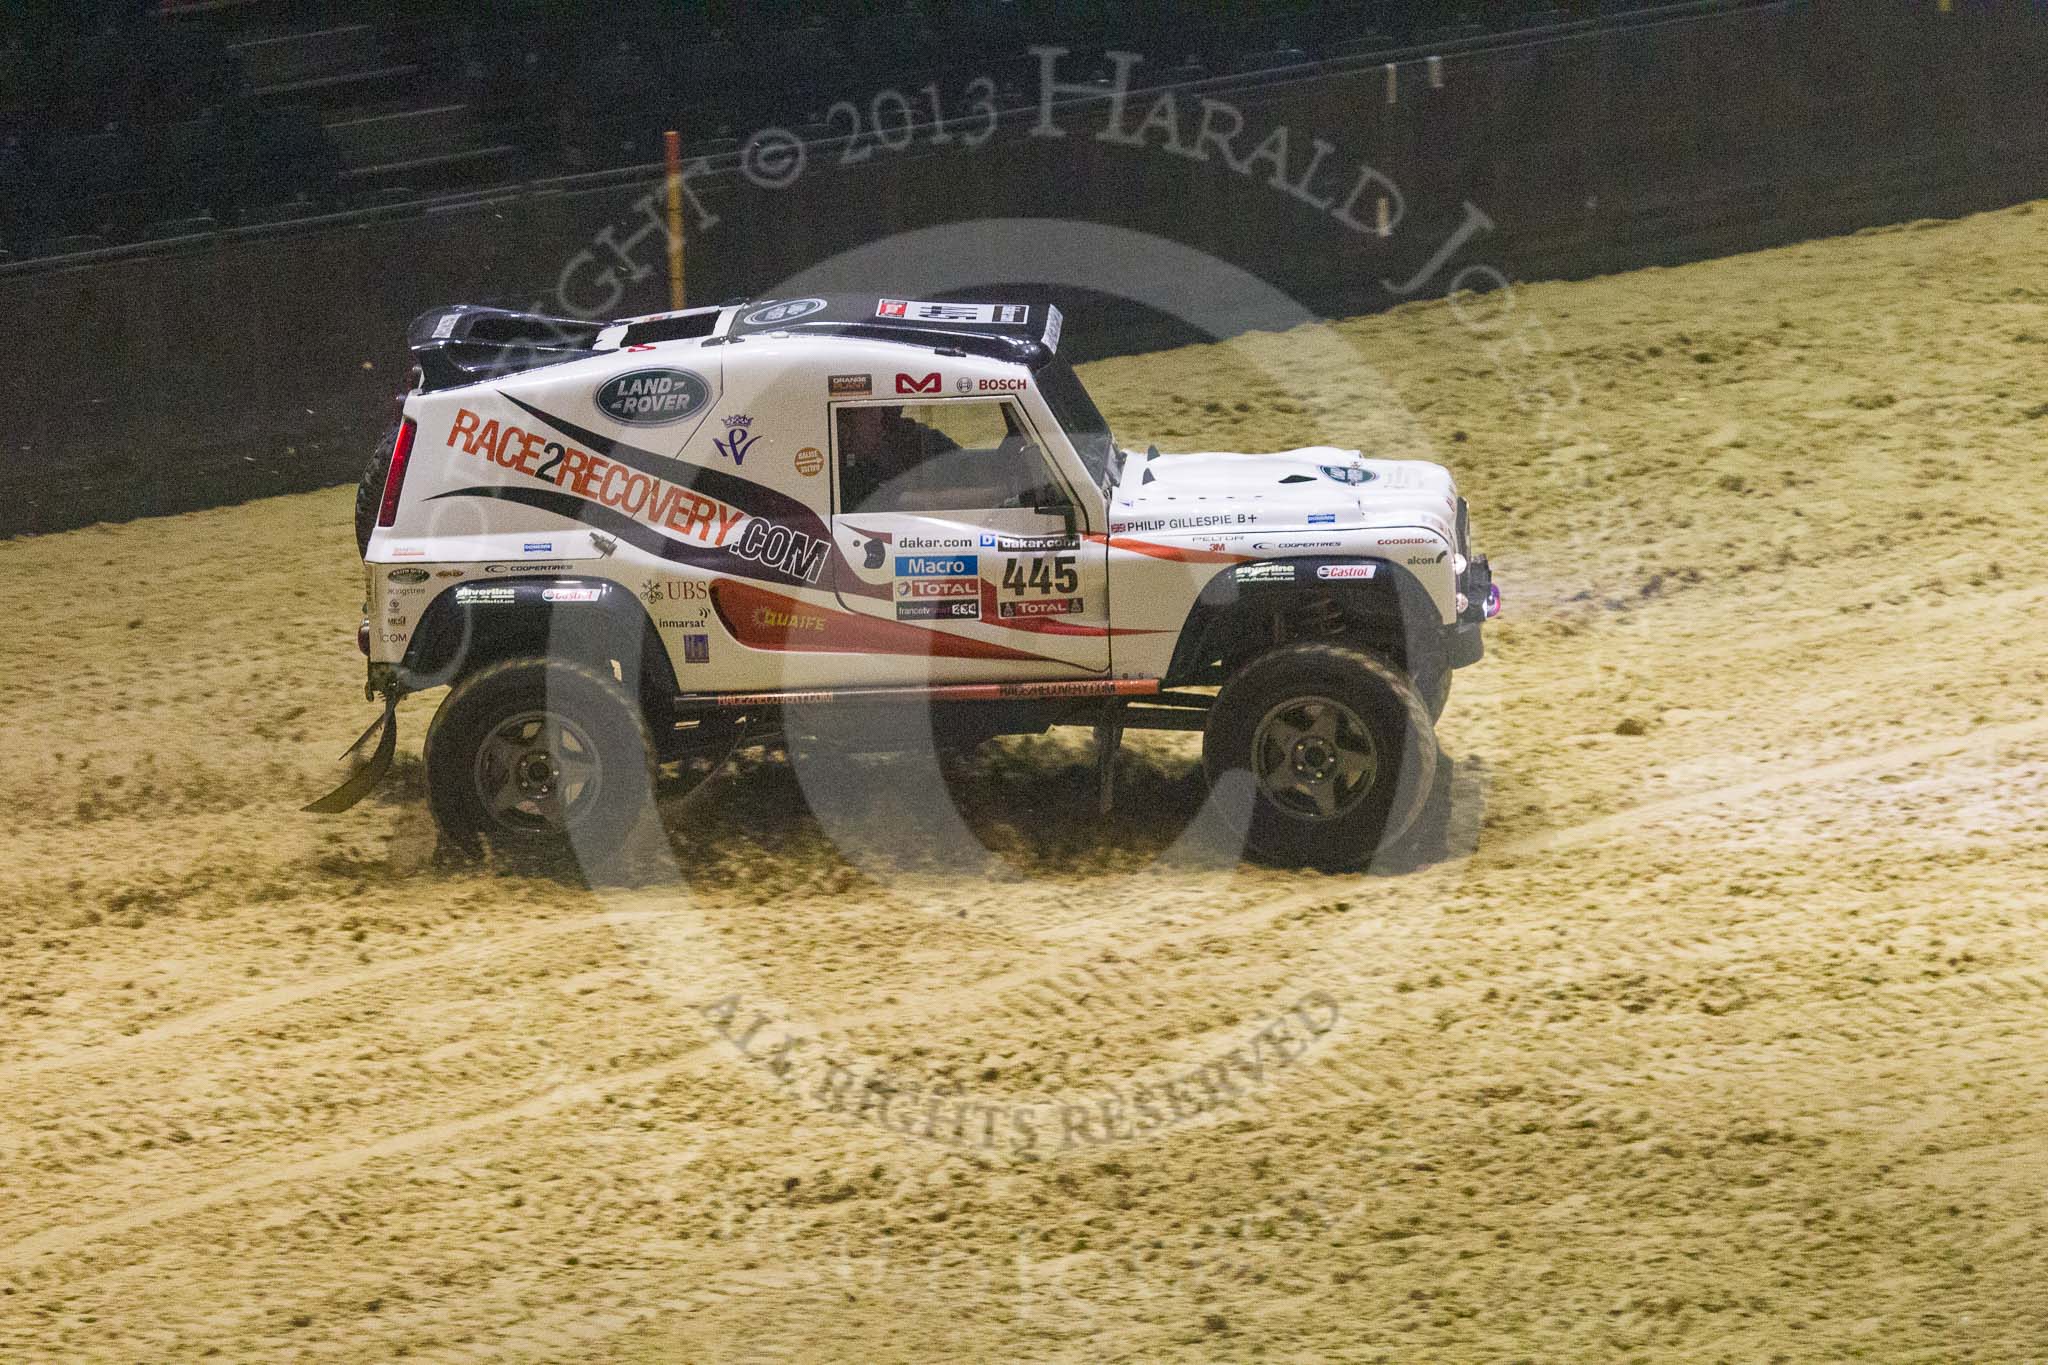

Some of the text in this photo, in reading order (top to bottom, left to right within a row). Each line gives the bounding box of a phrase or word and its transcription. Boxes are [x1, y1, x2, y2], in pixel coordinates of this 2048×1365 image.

[617, 378, 673, 397] LAND
[978, 378, 1027, 391] BOSCH
[622, 393, 691, 414] ROVER
[446, 407, 832, 585] RACE2RECOVERY.COM
[1127, 512, 1258, 532] PHILIP GILLESPIE B+
[899, 537, 973, 549] dakar.com
[1209, 543, 1226, 552] 3M
[908, 558, 965, 573] Macro
[1407, 556, 1434, 565] alcon
[1002, 556, 1078, 596] 445
[1330, 565, 1369, 578] Castrol
[665, 581, 708, 600] UBS
[914, 581, 976, 594] TOTAL
[1018, 602, 1067, 613] TOTAL
[659, 619, 705, 628] inmarsat
